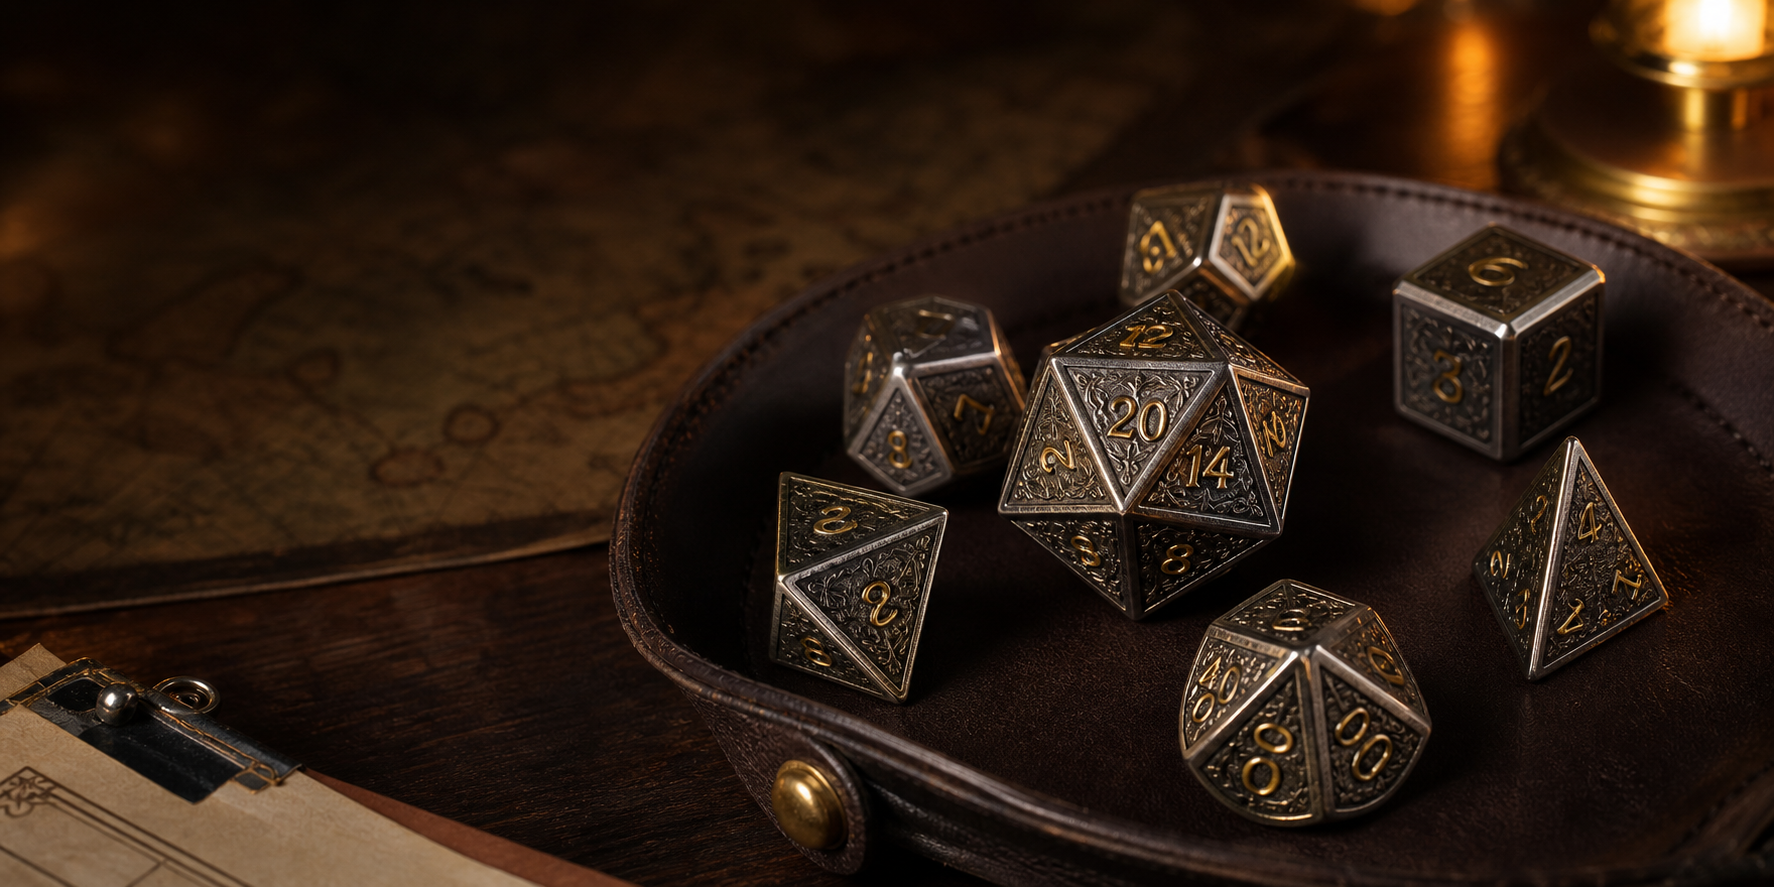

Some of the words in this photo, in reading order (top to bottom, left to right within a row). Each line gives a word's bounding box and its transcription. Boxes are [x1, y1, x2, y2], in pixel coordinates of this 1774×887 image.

[1468, 257, 1529, 287] 6
[1119, 324, 1175, 350] 12
[1543, 335, 1574, 396] 2
[1107, 395, 1169, 442] 20
[887, 430, 913, 469] 8
[1186, 444, 1234, 490] 14
[1578, 502, 1602, 544] 4
[1160, 543, 1195, 576] 8
